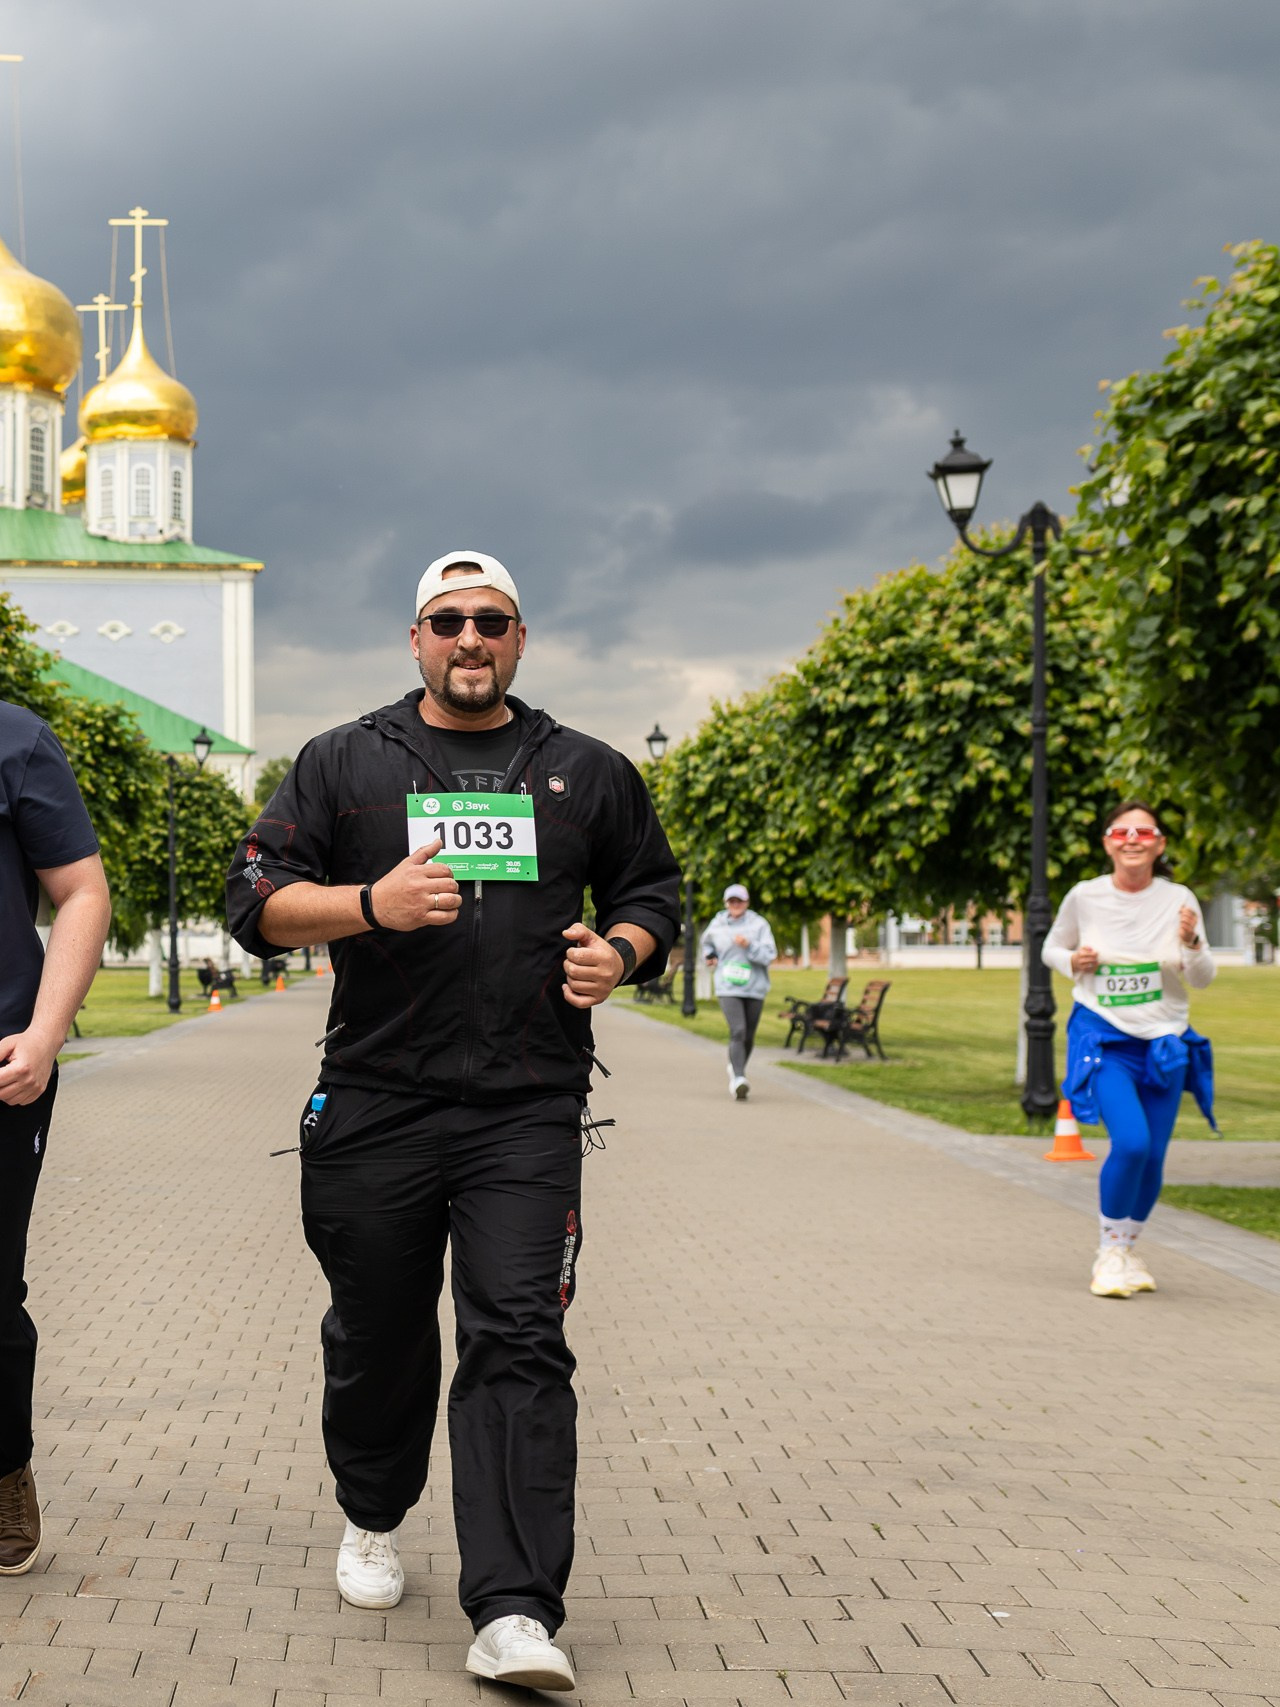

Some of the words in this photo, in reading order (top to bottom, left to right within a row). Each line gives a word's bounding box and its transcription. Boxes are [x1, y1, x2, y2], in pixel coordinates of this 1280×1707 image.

[465, 801, 490, 811] Звук
[433, 821, 514, 850] 1033
[1106, 975, 1150, 992] 0239
